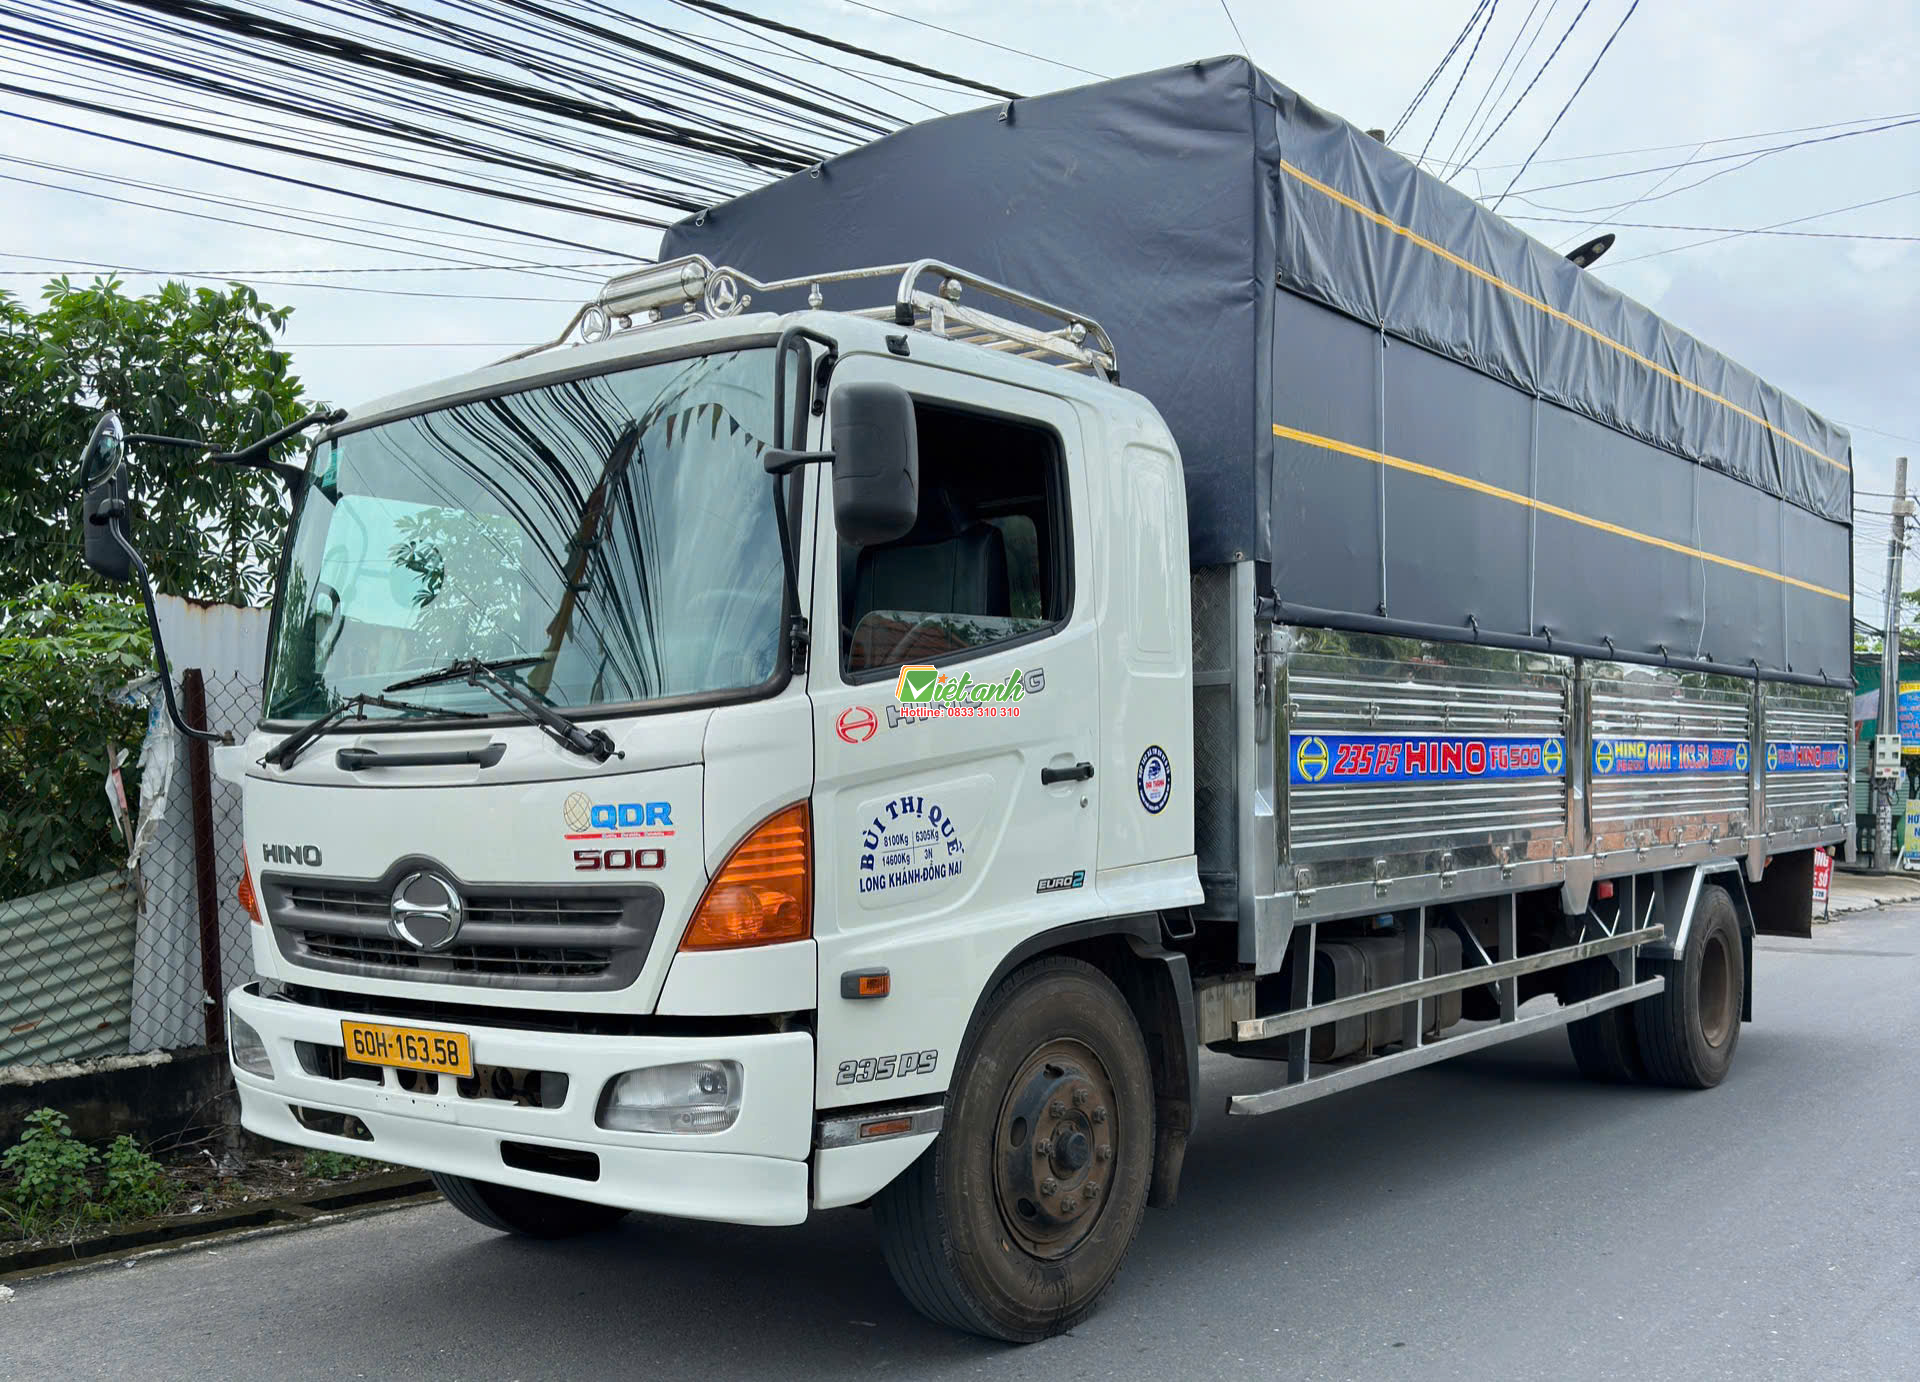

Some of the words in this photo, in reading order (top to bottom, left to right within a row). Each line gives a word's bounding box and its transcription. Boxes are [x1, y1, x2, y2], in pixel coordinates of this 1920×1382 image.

[1333, 744, 1375, 775] 235
[1374, 743, 1402, 774] PS
[1404, 741, 1486, 774] HINO
[1489, 745, 1508, 770] FG
[1509, 745, 1541, 769] 500
[1615, 742, 1647, 759] HINO
[1796, 746, 1821, 767] HINO
[591, 802, 673, 830] QDR
[886, 796, 924, 819] THỊ
[883, 834, 909, 847] 8100Kg
[262, 843, 323, 867] HINO
[573, 848, 667, 871] 500
[882, 853, 911, 867] 14600Kg
[859, 874, 886, 893] LONG
[948, 860, 962, 877] NAI
[353, 1029, 459, 1066] 60H-163.58
[836, 1055, 897, 1085] 235
[897, 1050, 938, 1077] PS
